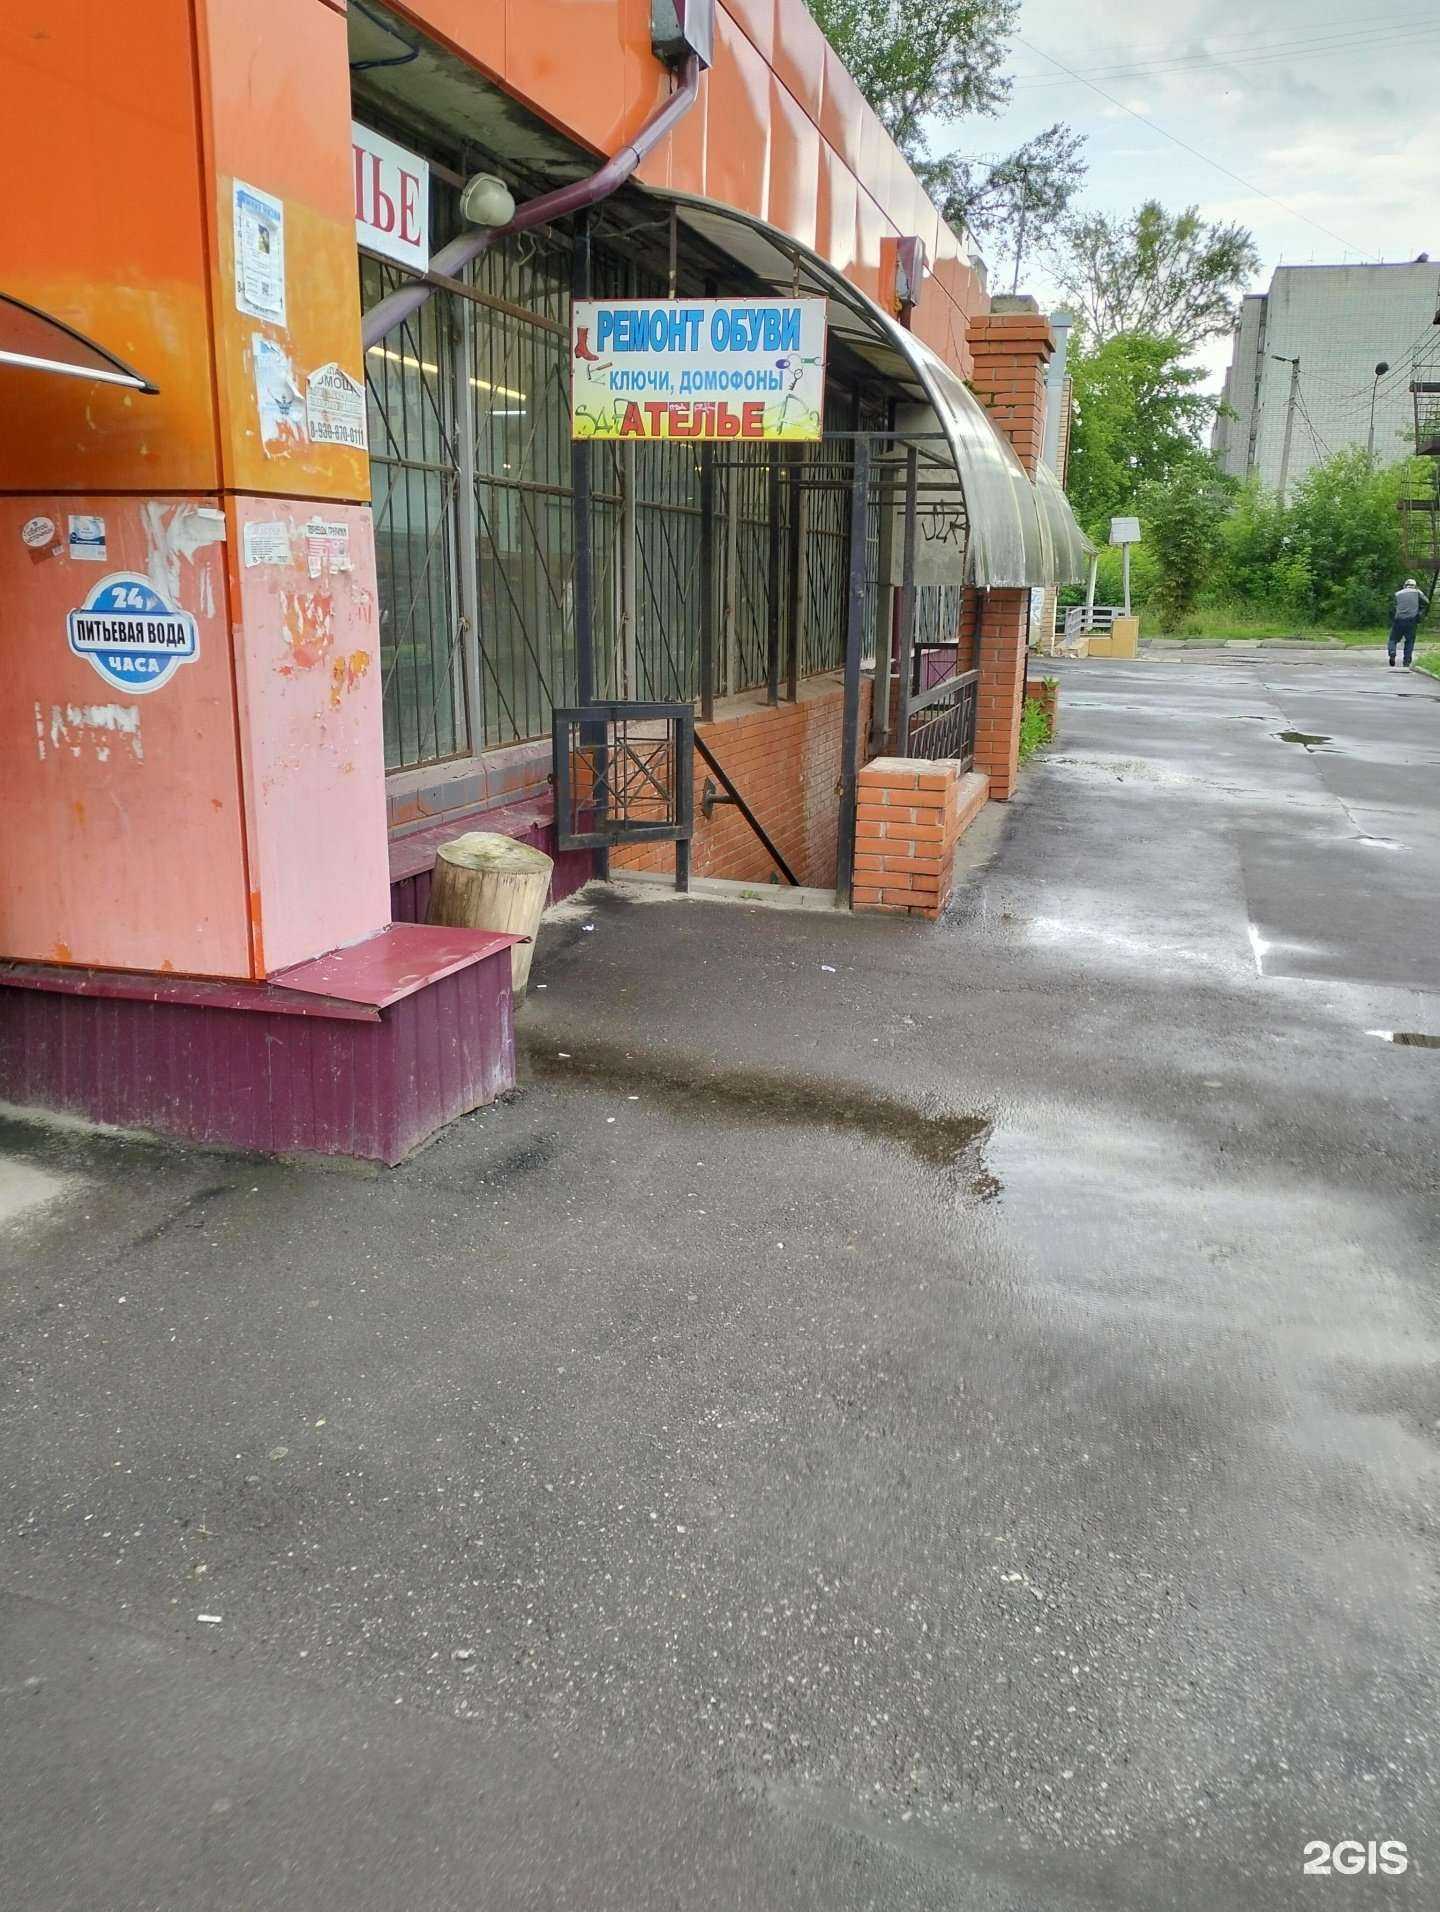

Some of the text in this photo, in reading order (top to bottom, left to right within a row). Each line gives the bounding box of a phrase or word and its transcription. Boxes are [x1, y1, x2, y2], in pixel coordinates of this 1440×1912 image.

[597, 307, 801, 353] РЕМОНТ ОБУВИ
[609, 369, 784, 396] КЛЮЧИ, ДОМОФОНЫ
[619, 401, 766, 438] АТЕЛЬЕ
[111, 586, 144, 609] 24
[76, 619, 187, 648] ПИТЬЕВАЯ ВОДА
[108, 656, 161, 673] ЧАСА
